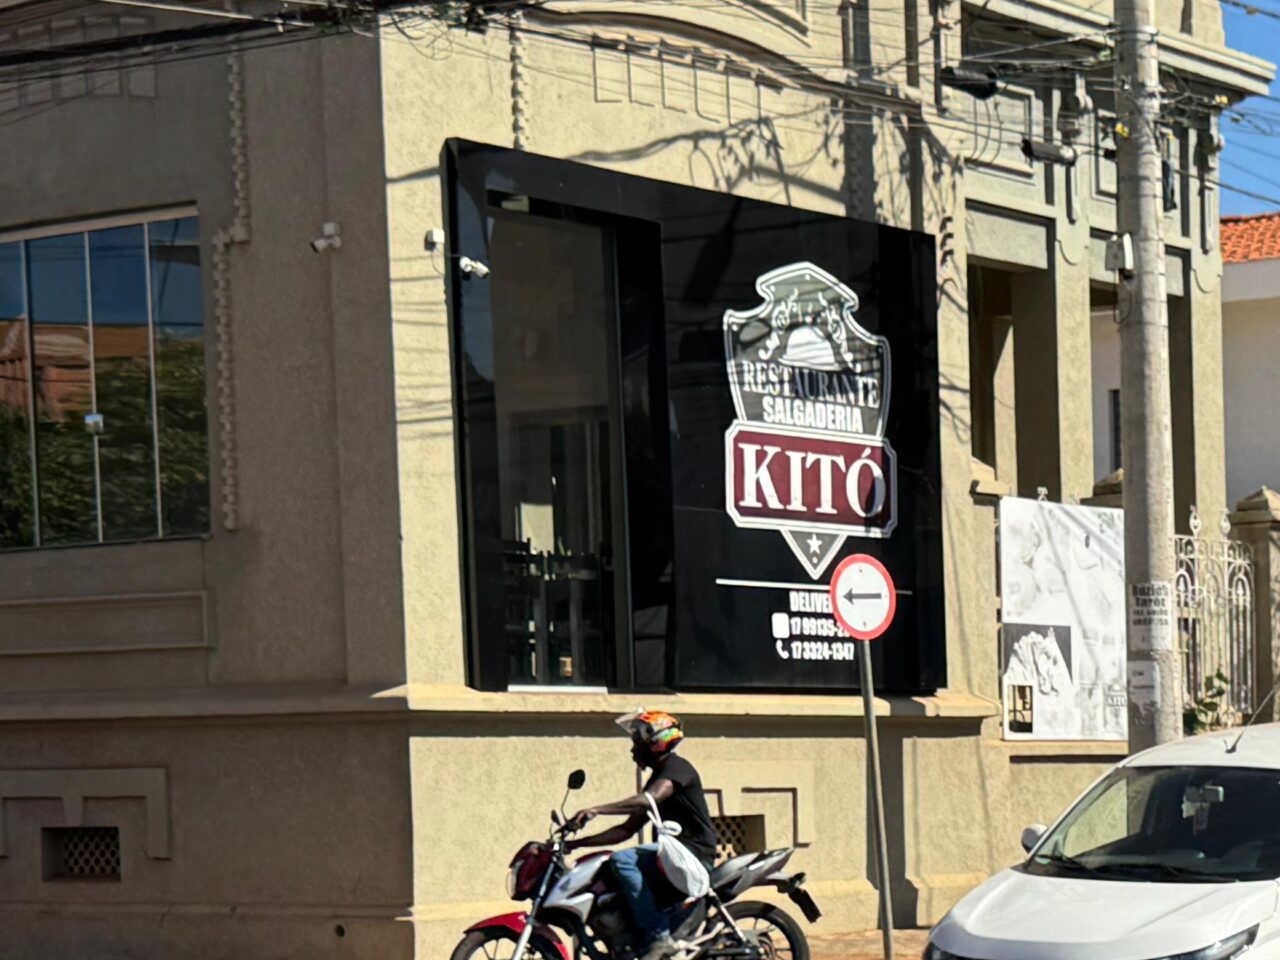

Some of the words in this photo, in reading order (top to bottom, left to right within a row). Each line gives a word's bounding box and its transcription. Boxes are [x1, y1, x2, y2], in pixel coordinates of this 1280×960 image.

[741, 359, 881, 410] RESTAURANTE
[762, 395, 864, 434] SALGADERIA
[738, 443, 887, 519] KITÓ
[789, 591, 833, 614] DELIVE
[790, 641, 803, 659] 17
